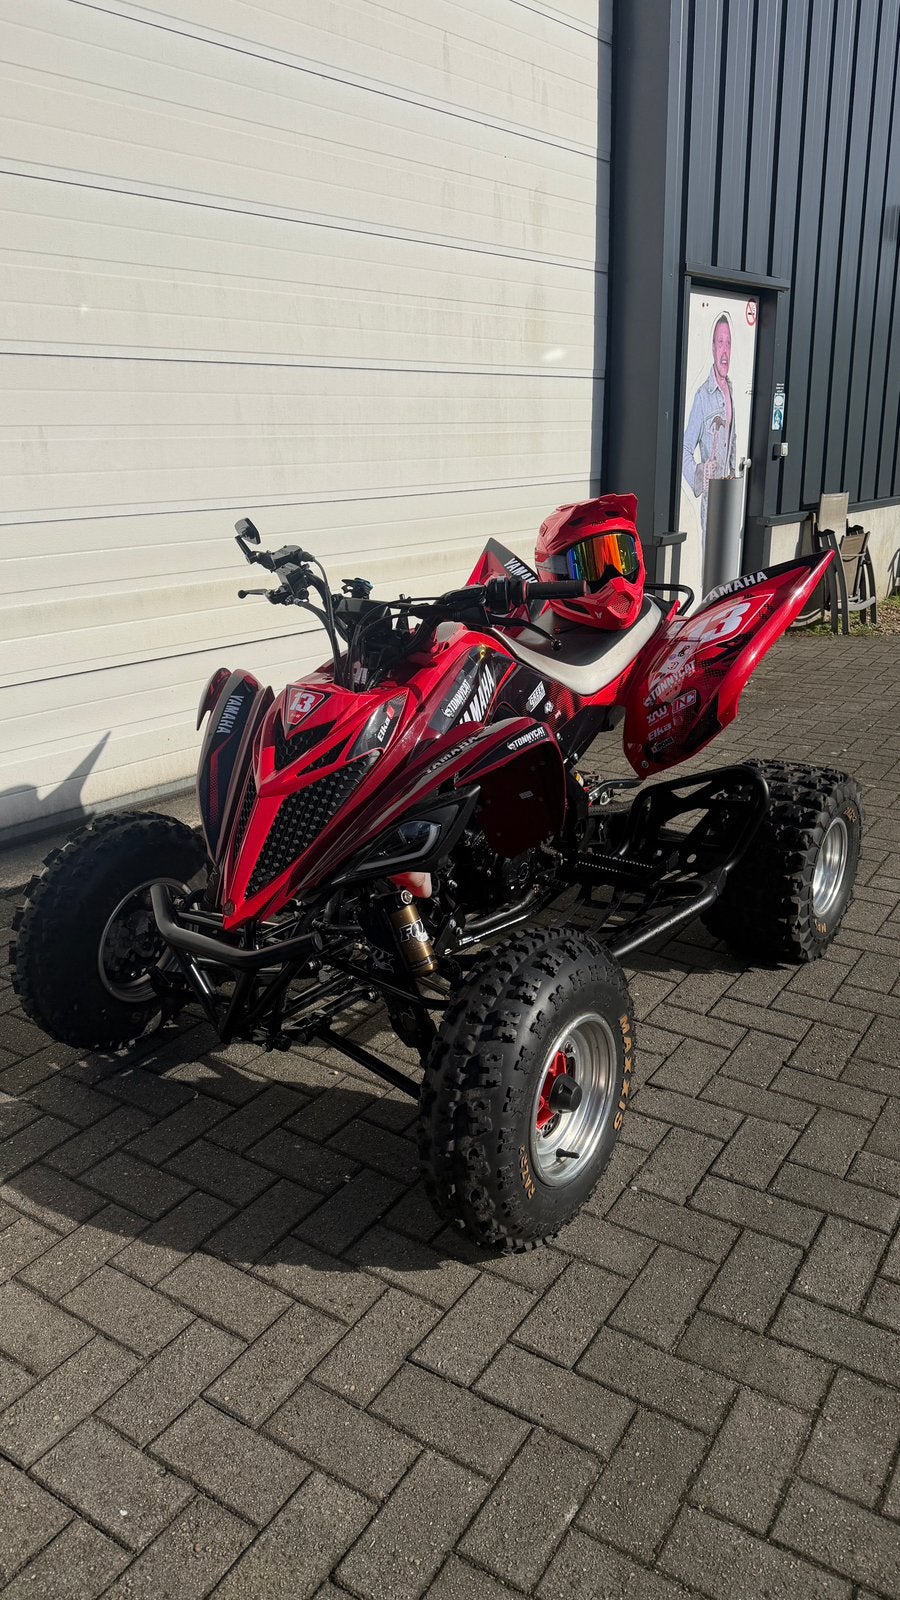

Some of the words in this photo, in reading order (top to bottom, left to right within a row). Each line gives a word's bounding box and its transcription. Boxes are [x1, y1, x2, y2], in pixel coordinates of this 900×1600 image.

[504, 557, 538, 583] YAMAH
[703, 571, 768, 602] AMAHA
[686, 603, 751, 643] 13
[290, 692, 316, 712] 13
[459, 663, 495, 724] AMAHA
[216, 695, 244, 733] YAMAHA
[613, 1014, 632, 1131] MAXXIS
